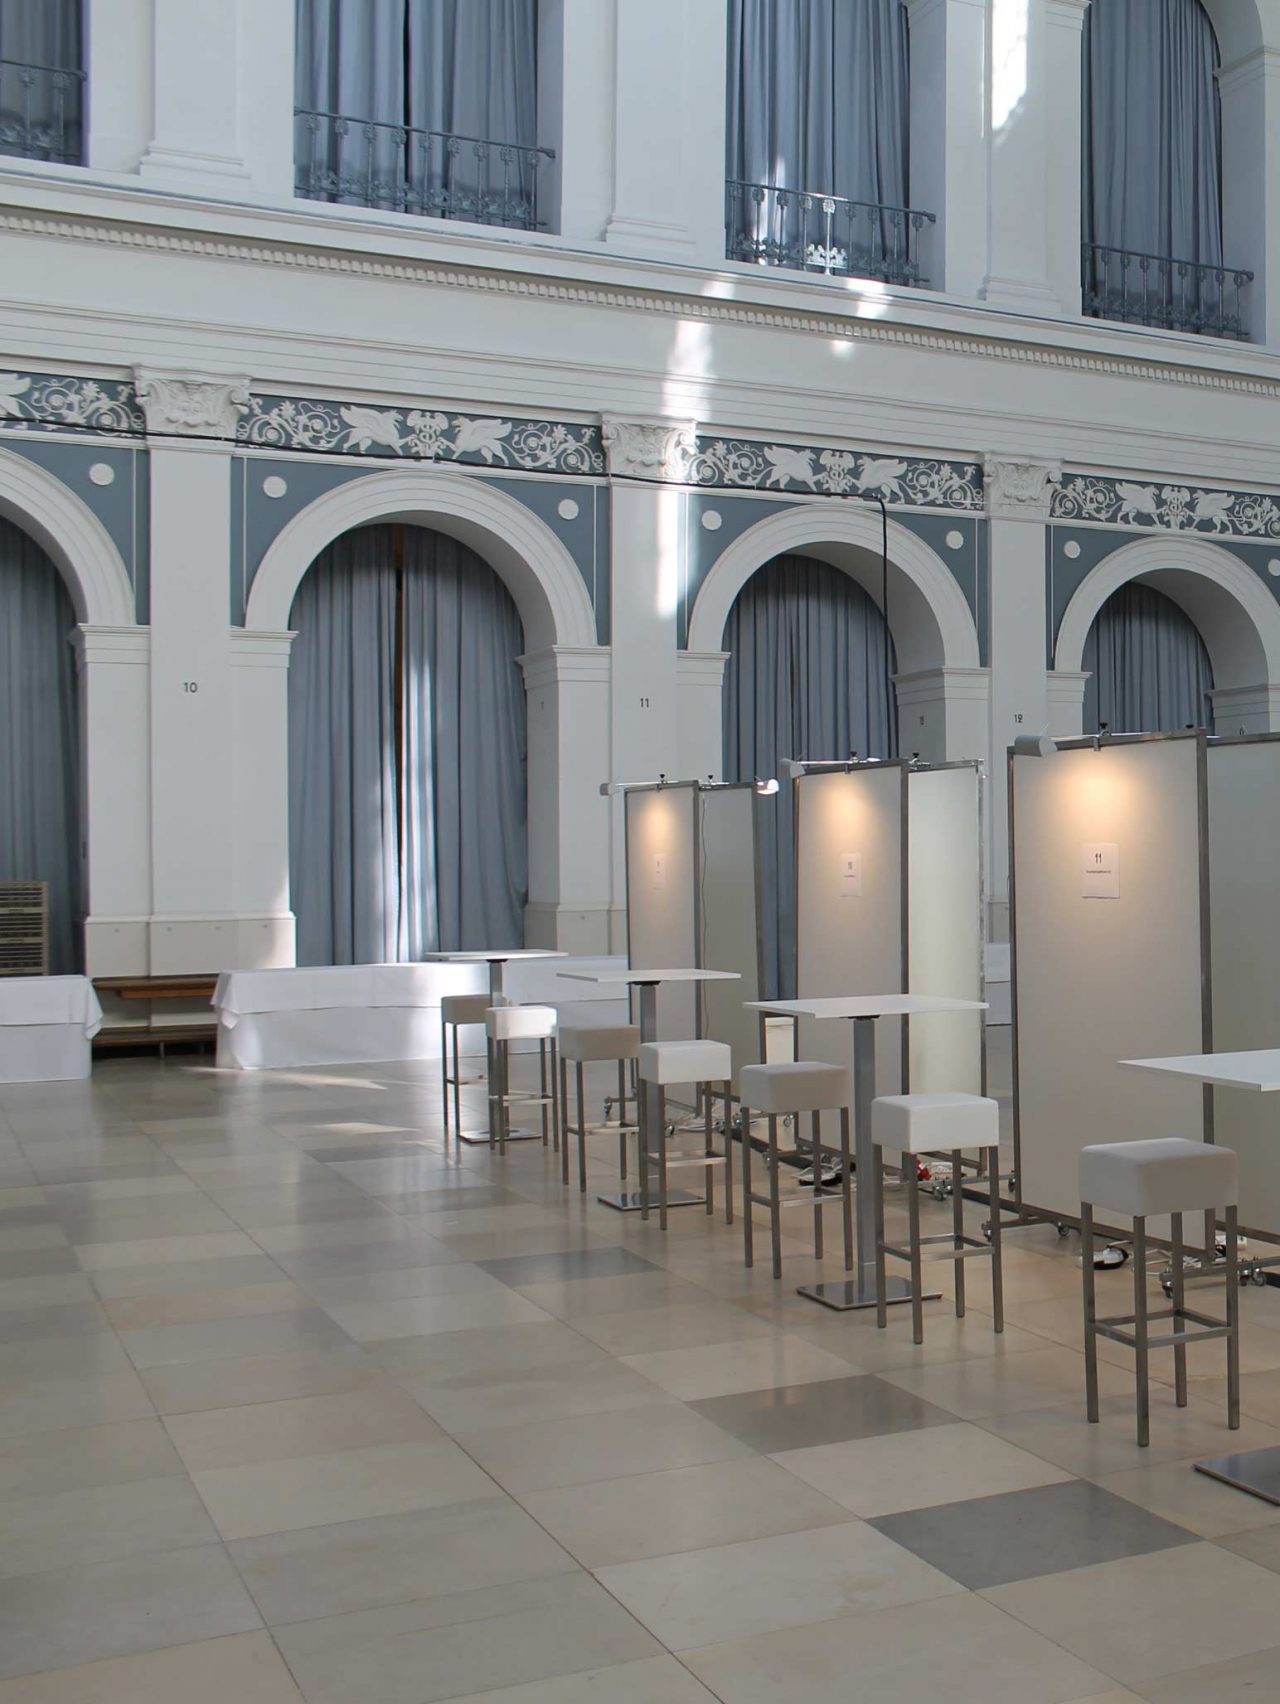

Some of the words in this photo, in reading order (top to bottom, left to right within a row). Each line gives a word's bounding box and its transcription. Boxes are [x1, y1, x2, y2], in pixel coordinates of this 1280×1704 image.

[184, 682, 198, 693] 10
[640, 698, 649, 708] 11
[1095, 852, 1102, 865] 11
